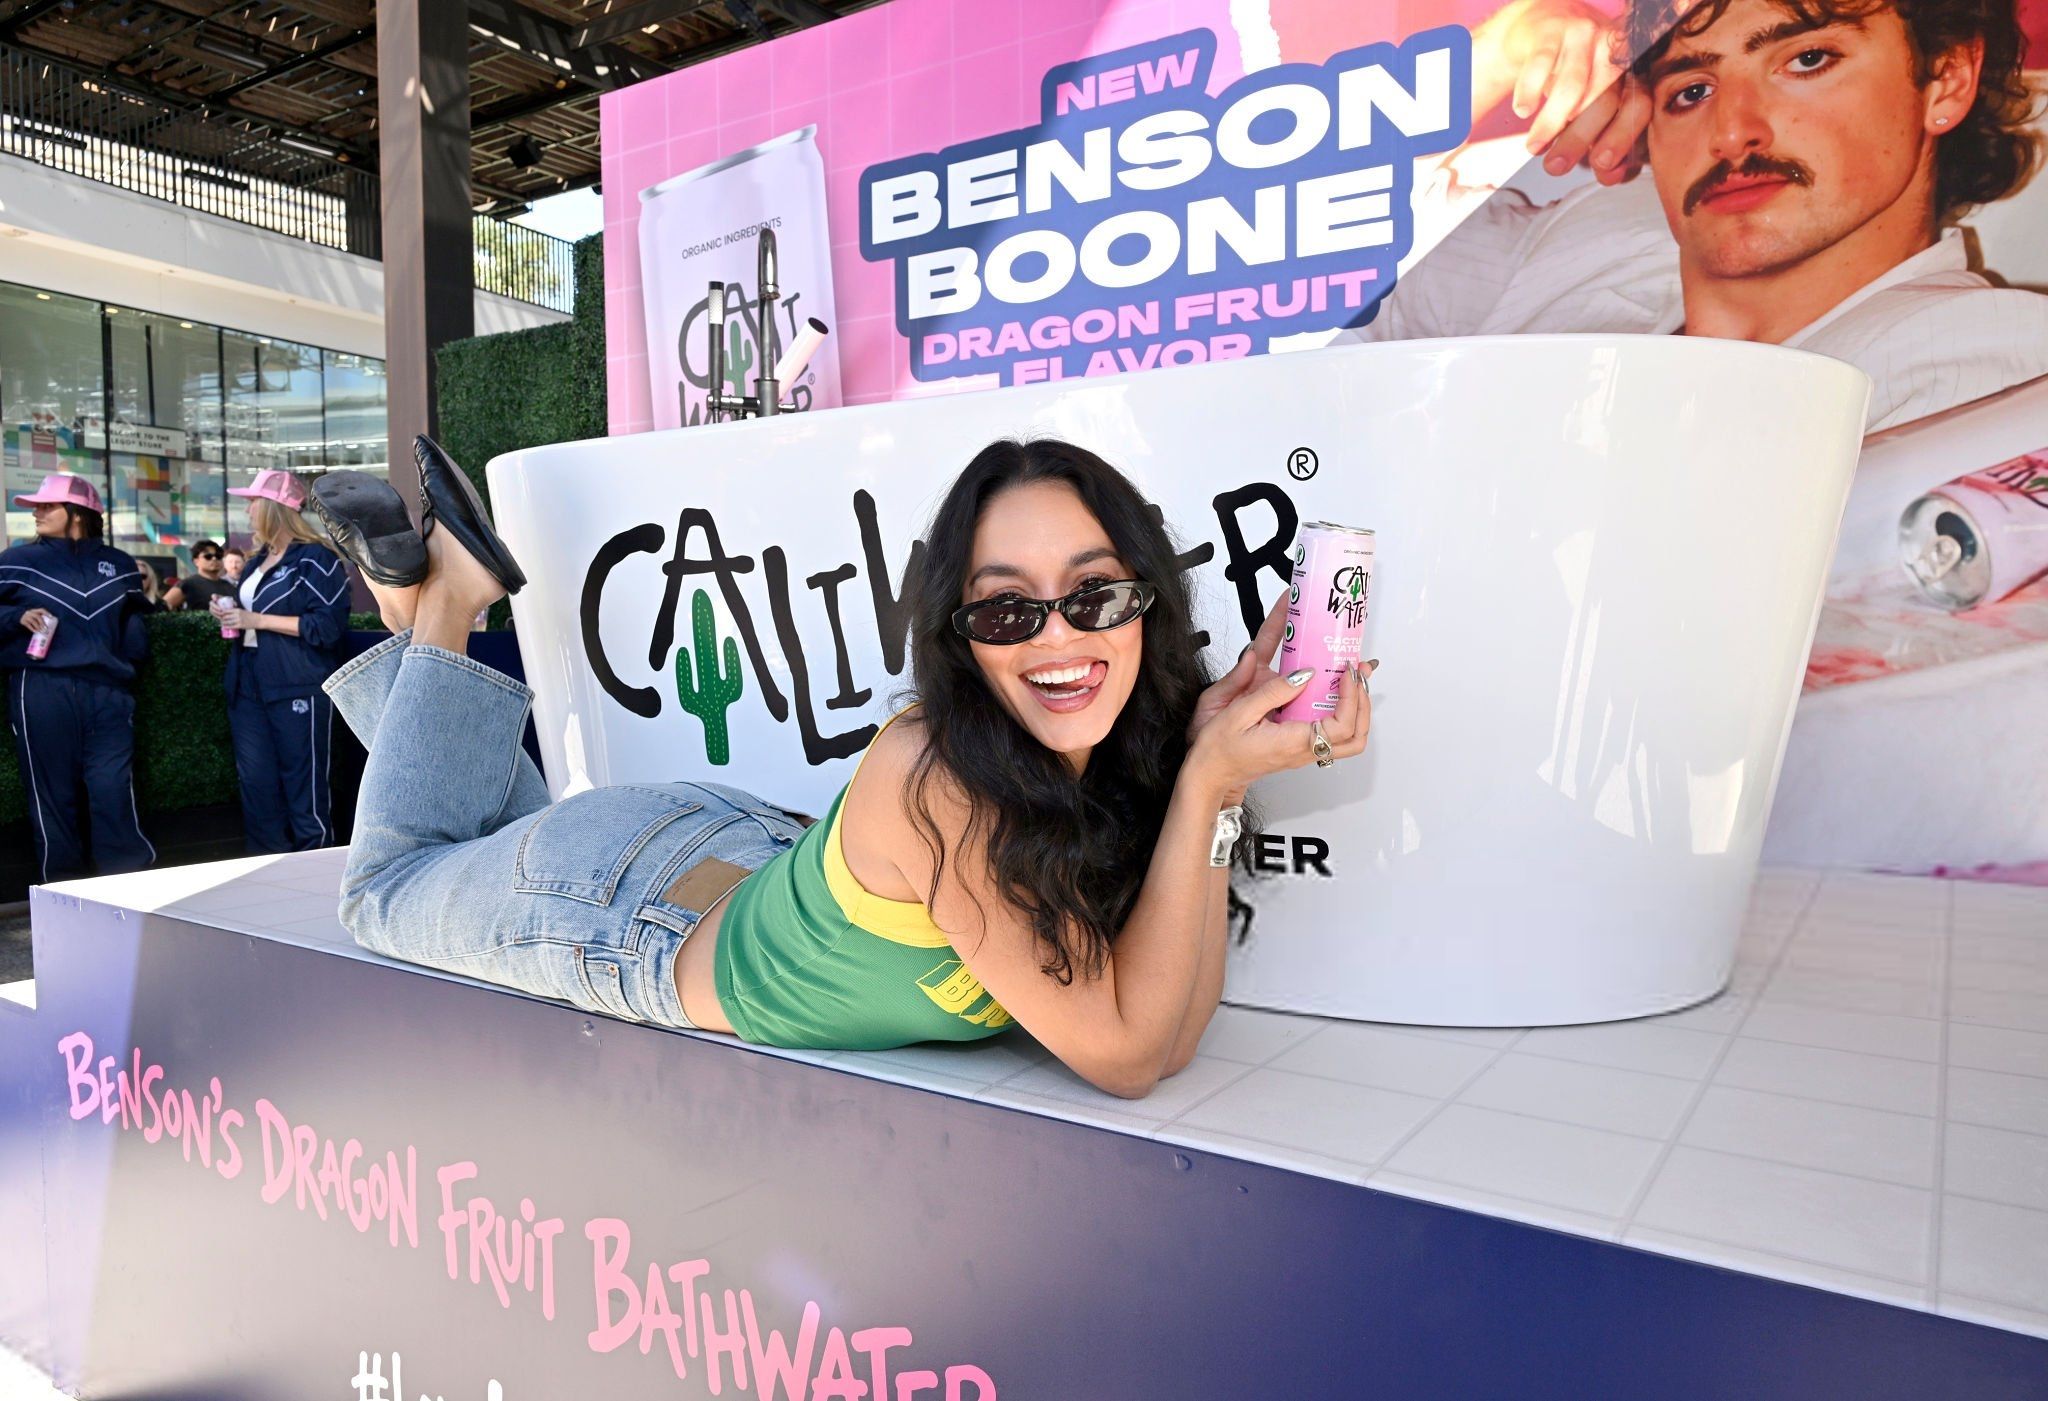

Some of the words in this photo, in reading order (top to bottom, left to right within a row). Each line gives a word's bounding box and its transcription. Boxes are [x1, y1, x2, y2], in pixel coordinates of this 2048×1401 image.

[1056, 49, 1200, 116] NEW
[871, 48, 1451, 245] BENSON
[681, 237, 722, 260] ORGANIC
[908, 164, 1394, 320] BOONE
[923, 302, 1160, 366] DRAGON
[1175, 269, 1377, 331] FRUIT
[58, 1031, 244, 1180] BENSON'S
[255, 1098, 418, 1248] DRAGON
